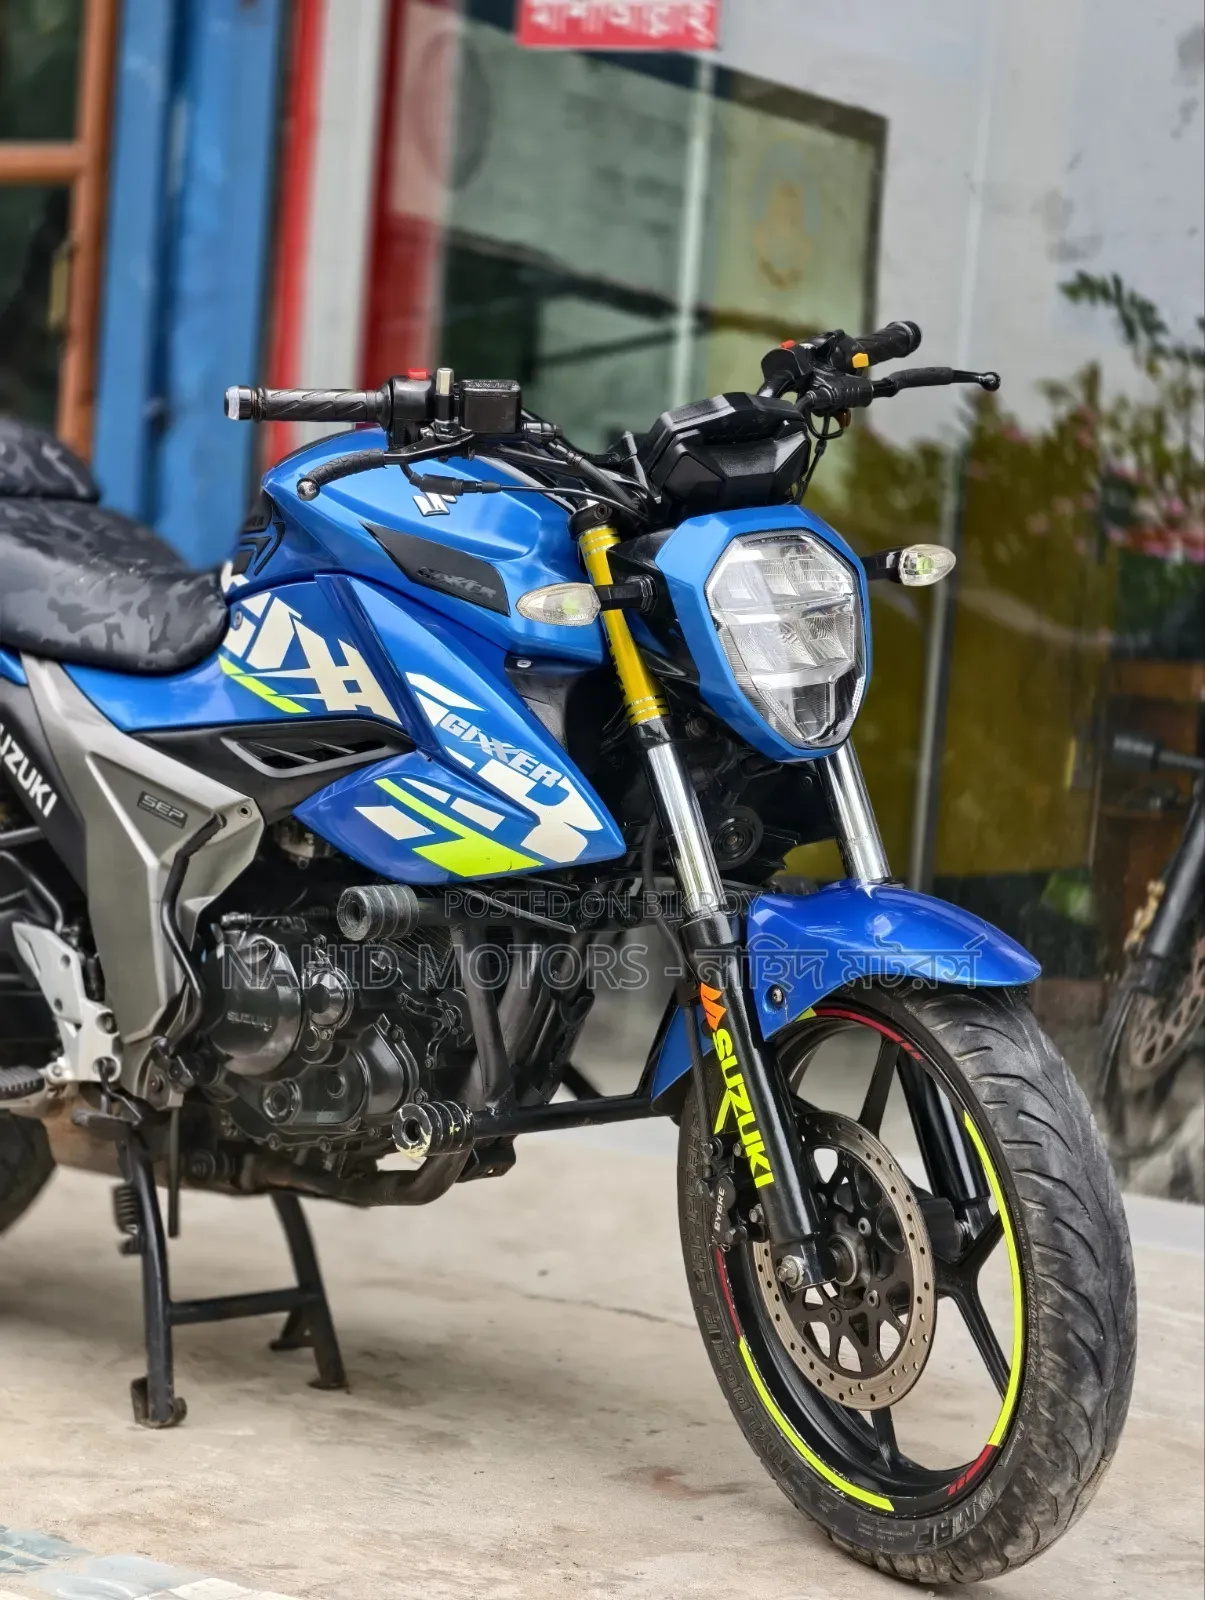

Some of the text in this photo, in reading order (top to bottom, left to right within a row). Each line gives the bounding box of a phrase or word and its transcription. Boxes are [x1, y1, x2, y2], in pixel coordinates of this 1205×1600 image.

[440, 713, 563, 788] GIXXER
[142, 794, 185, 819] SEP
[713, 1028, 775, 1189] SUZUKI
[713, 1186, 726, 1232] BYBRE
